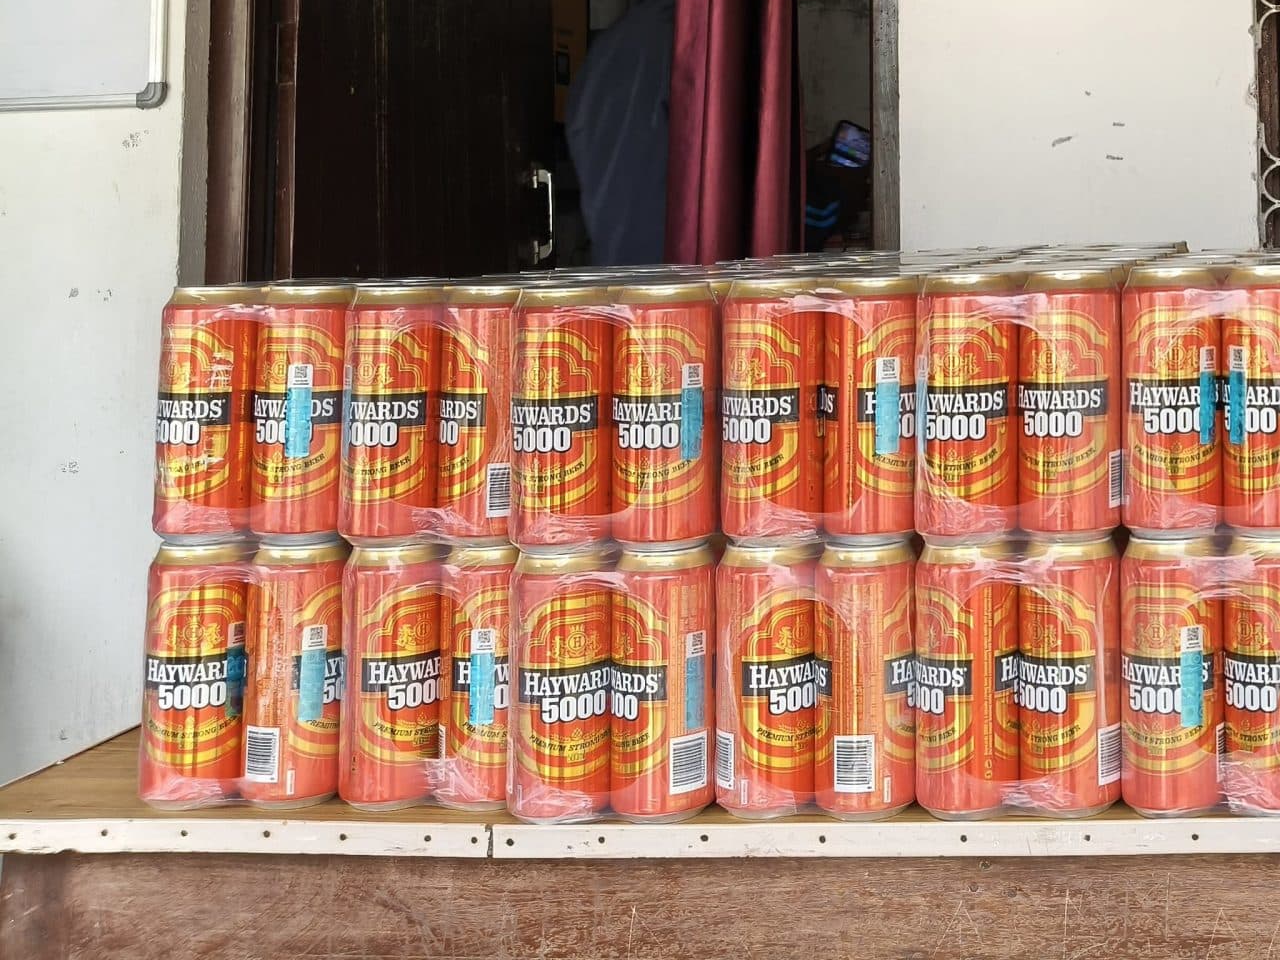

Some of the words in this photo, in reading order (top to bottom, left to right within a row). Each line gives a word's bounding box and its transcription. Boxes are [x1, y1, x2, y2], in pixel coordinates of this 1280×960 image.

[1018, 385, 1101, 410] HAYWARDS
[512, 399, 591, 426] AYWARDS
[1024, 411, 1082, 437] 5000
[350, 422, 398, 446] 000
[514, 427, 571, 452] 5000
[619, 423, 680, 449] 5000
[926, 414, 986, 440] 5000
[524, 666, 610, 696] HAYWARD
[158, 681, 227, 710] 5000
[541, 690, 606, 724] 5000
[1225, 681, 1277, 713] 5000
